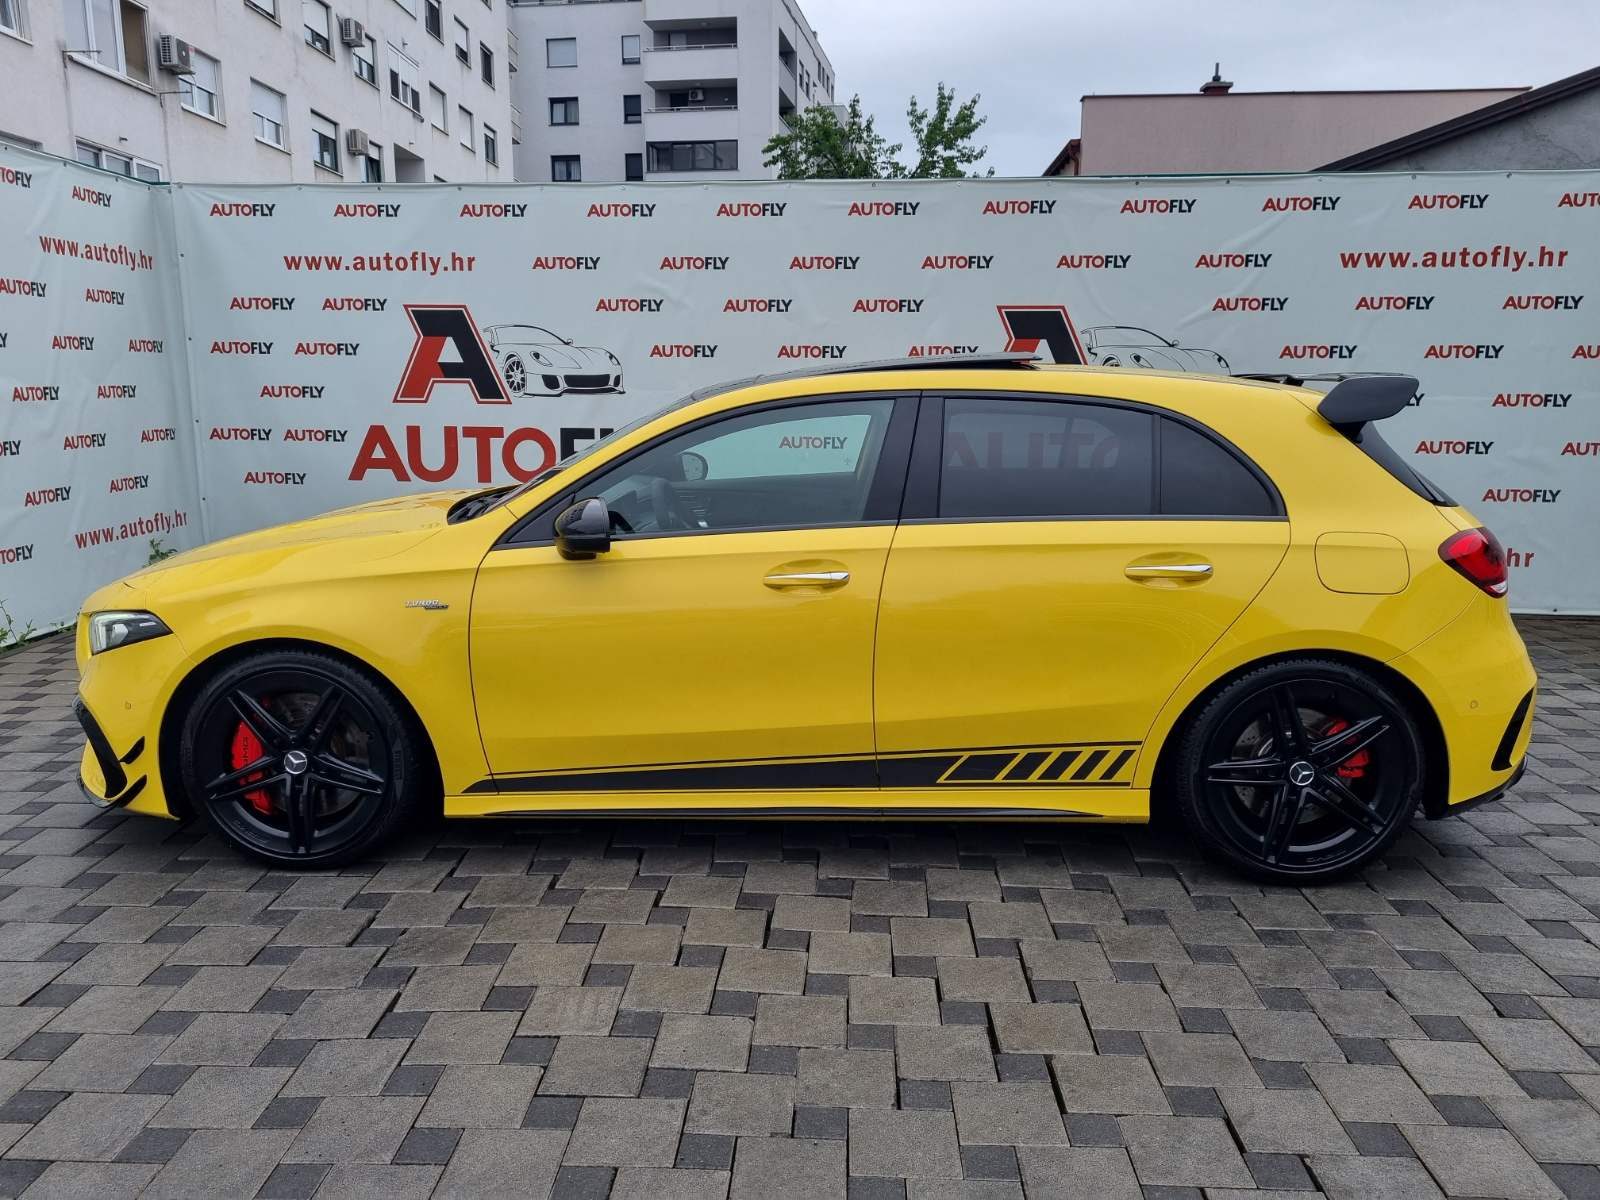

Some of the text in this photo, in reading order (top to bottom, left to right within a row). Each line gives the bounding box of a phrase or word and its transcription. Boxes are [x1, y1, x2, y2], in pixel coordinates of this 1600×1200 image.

[72, 186, 111, 207] AUTOFLY
[1408, 195, 1489, 209] AUTOFLY
[210, 204, 275, 216] AUTOFLY
[460, 204, 527, 217] AUTOFLY
[587, 204, 656, 217] AUTOFLY
[717, 203, 787, 216] AUTOFLY
[848, 202, 920, 216] AUTOFLY
[983, 200, 1056, 214] AUTOFLY
[1120, 199, 1196, 213] AUTOFLY
[1262, 197, 1340, 211] AUTOFLY
[334, 205, 400, 217] AUTOFLY
[40, 236, 152, 271] www.autofly.hr
[1340, 246, 1568, 272] www.autofly.hr
[284, 252, 475, 275] www.autofly.hr
[532, 257, 600, 270] AUTOFLY
[660, 257, 729, 270] AUTOFLY
[789, 257, 860, 269] AUTOFLY
[922, 256, 994, 269] AUTOFLY
[1057, 255, 1131, 268] AUTOFLY
[1196, 254, 1272, 268] AUTOFLY
[0, 278, 46, 297] AUTOFLY
[86, 289, 124, 305] AUTOFLY
[230, 297, 295, 310] AUTOFLY
[1356, 296, 1434, 310] AUTOFLY
[1503, 296, 1584, 309] AUTOFLY
[322, 298, 387, 311] AUTOFLY
[596, 299, 663, 312] AUTOFLY
[723, 300, 792, 312] AUTOFLY
[853, 299, 924, 312] AUTOFLY
[1212, 298, 1288, 311] AUTOFLY
[52, 336, 94, 350] AUTOFLY
[129, 340, 163, 353] AUTOFLY
[210, 342, 273, 354] AUTOFLY
[295, 343, 359, 355] AUTOFLY
[650, 345, 718, 357] AUTOFLY
[778, 346, 847, 358] AUTOFLY
[1280, 345, 1357, 358] AUTOFLY
[1424, 345, 1504, 358] AUTOFLY
[13, 386, 59, 402] AUTOFLY
[98, 385, 136, 398] AUTOFLY
[260, 386, 324, 398] AUTOFLY
[1492, 394, 1572, 407] AUTOFLY
[141, 428, 176, 442] AUTOFLY
[210, 428, 272, 440] AUTOFLY
[284, 429, 348, 442] AUTOFLY
[64, 433, 106, 450] AUTOFLY
[779, 436, 847, 449] AUTOFLY
[1415, 441, 1494, 454] AUTOFLY
[348, 424, 614, 483] AUTOF
[110, 475, 148, 493] AUTOFLY
[244, 472, 306, 485] AUTOFLY
[25, 486, 71, 506] AUTOFLY
[1482, 489, 1561, 502] AUTOFLY
[75, 510, 187, 549] www.autofly.hr
